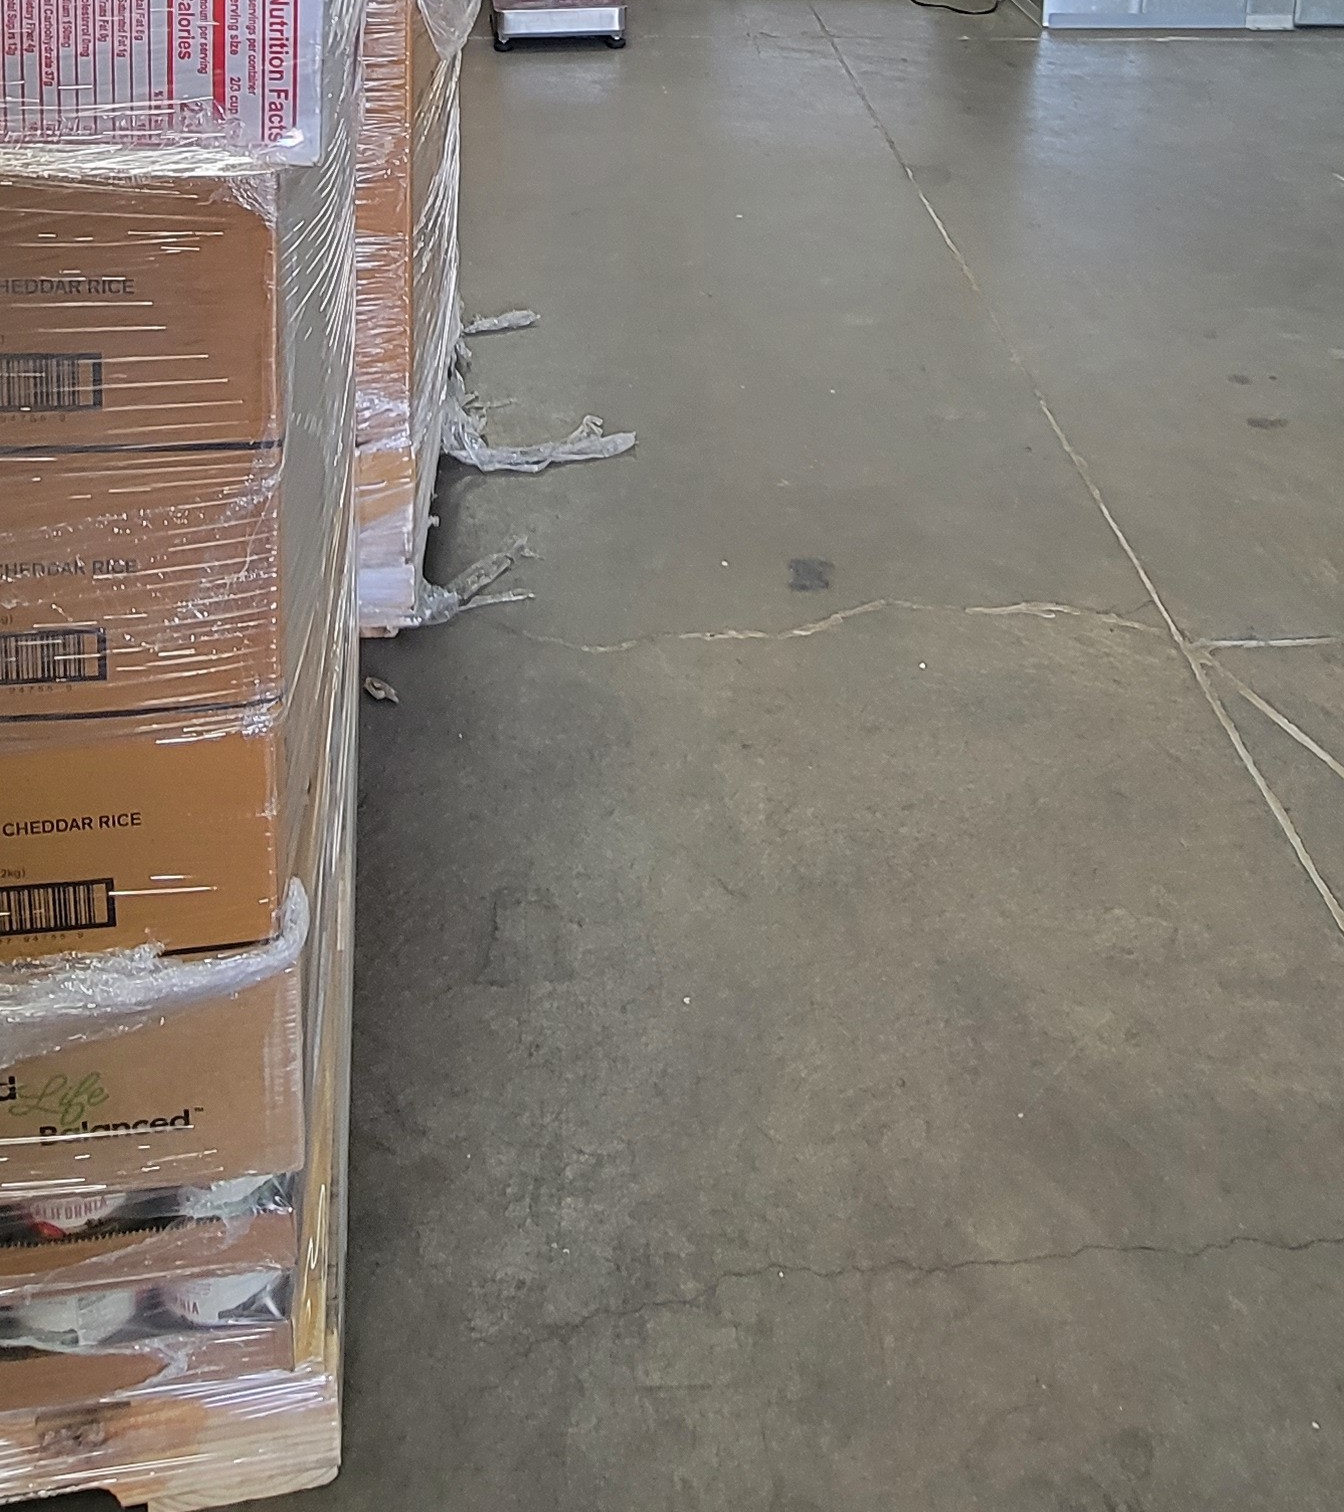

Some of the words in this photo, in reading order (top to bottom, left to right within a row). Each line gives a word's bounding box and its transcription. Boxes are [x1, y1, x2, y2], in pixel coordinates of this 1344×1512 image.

[42, 8, 55, 69] Carbohydrate
[197, 25, 208, 41] per
[6, 41, 17, 56] 12g
[24, 43, 36, 54] 4g
[229, 34, 242, 56] size
[245, 37, 258, 53] per
[197, 41, 209, 75] serving
[43, 70, 55, 87] 37g
[229, 76, 241, 93] 2/3
[247, 54, 258, 96] container
[227, 94, 240, 115] cup
[267, 88, 290, 143] Facts
[86, 277, 135, 295] RICE
[1, 814, 94, 839] CHEDDAR
[98, 811, 143, 831] RICE
[9, 1071, 110, 1125] Life
